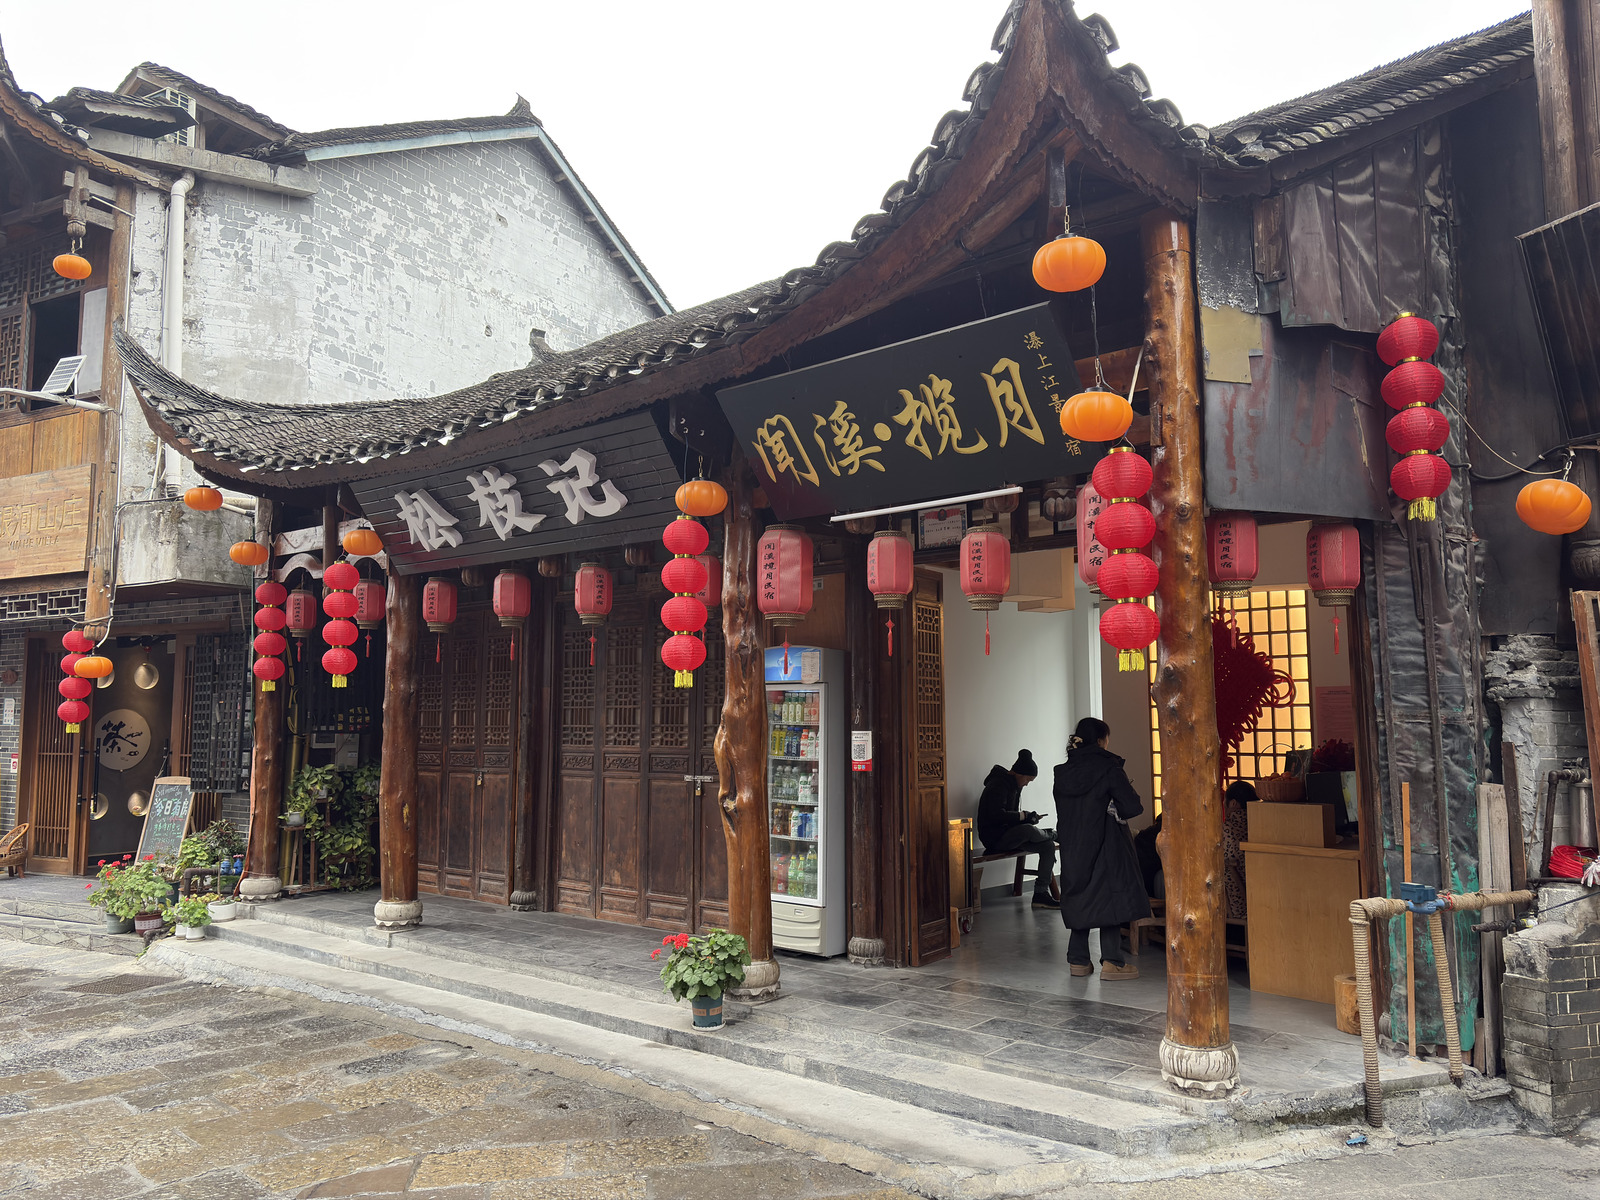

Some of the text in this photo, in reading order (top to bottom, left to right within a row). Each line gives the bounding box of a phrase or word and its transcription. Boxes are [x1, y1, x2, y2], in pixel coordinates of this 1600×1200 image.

[1023, 331, 1082, 457] 瀑上江景宿
[394, 447, 629, 553] 松枝记
[36, 535, 60, 547] VILLA
[101, 719, 138, 754] 茶
[156, 798, 189, 817] 今日有房
